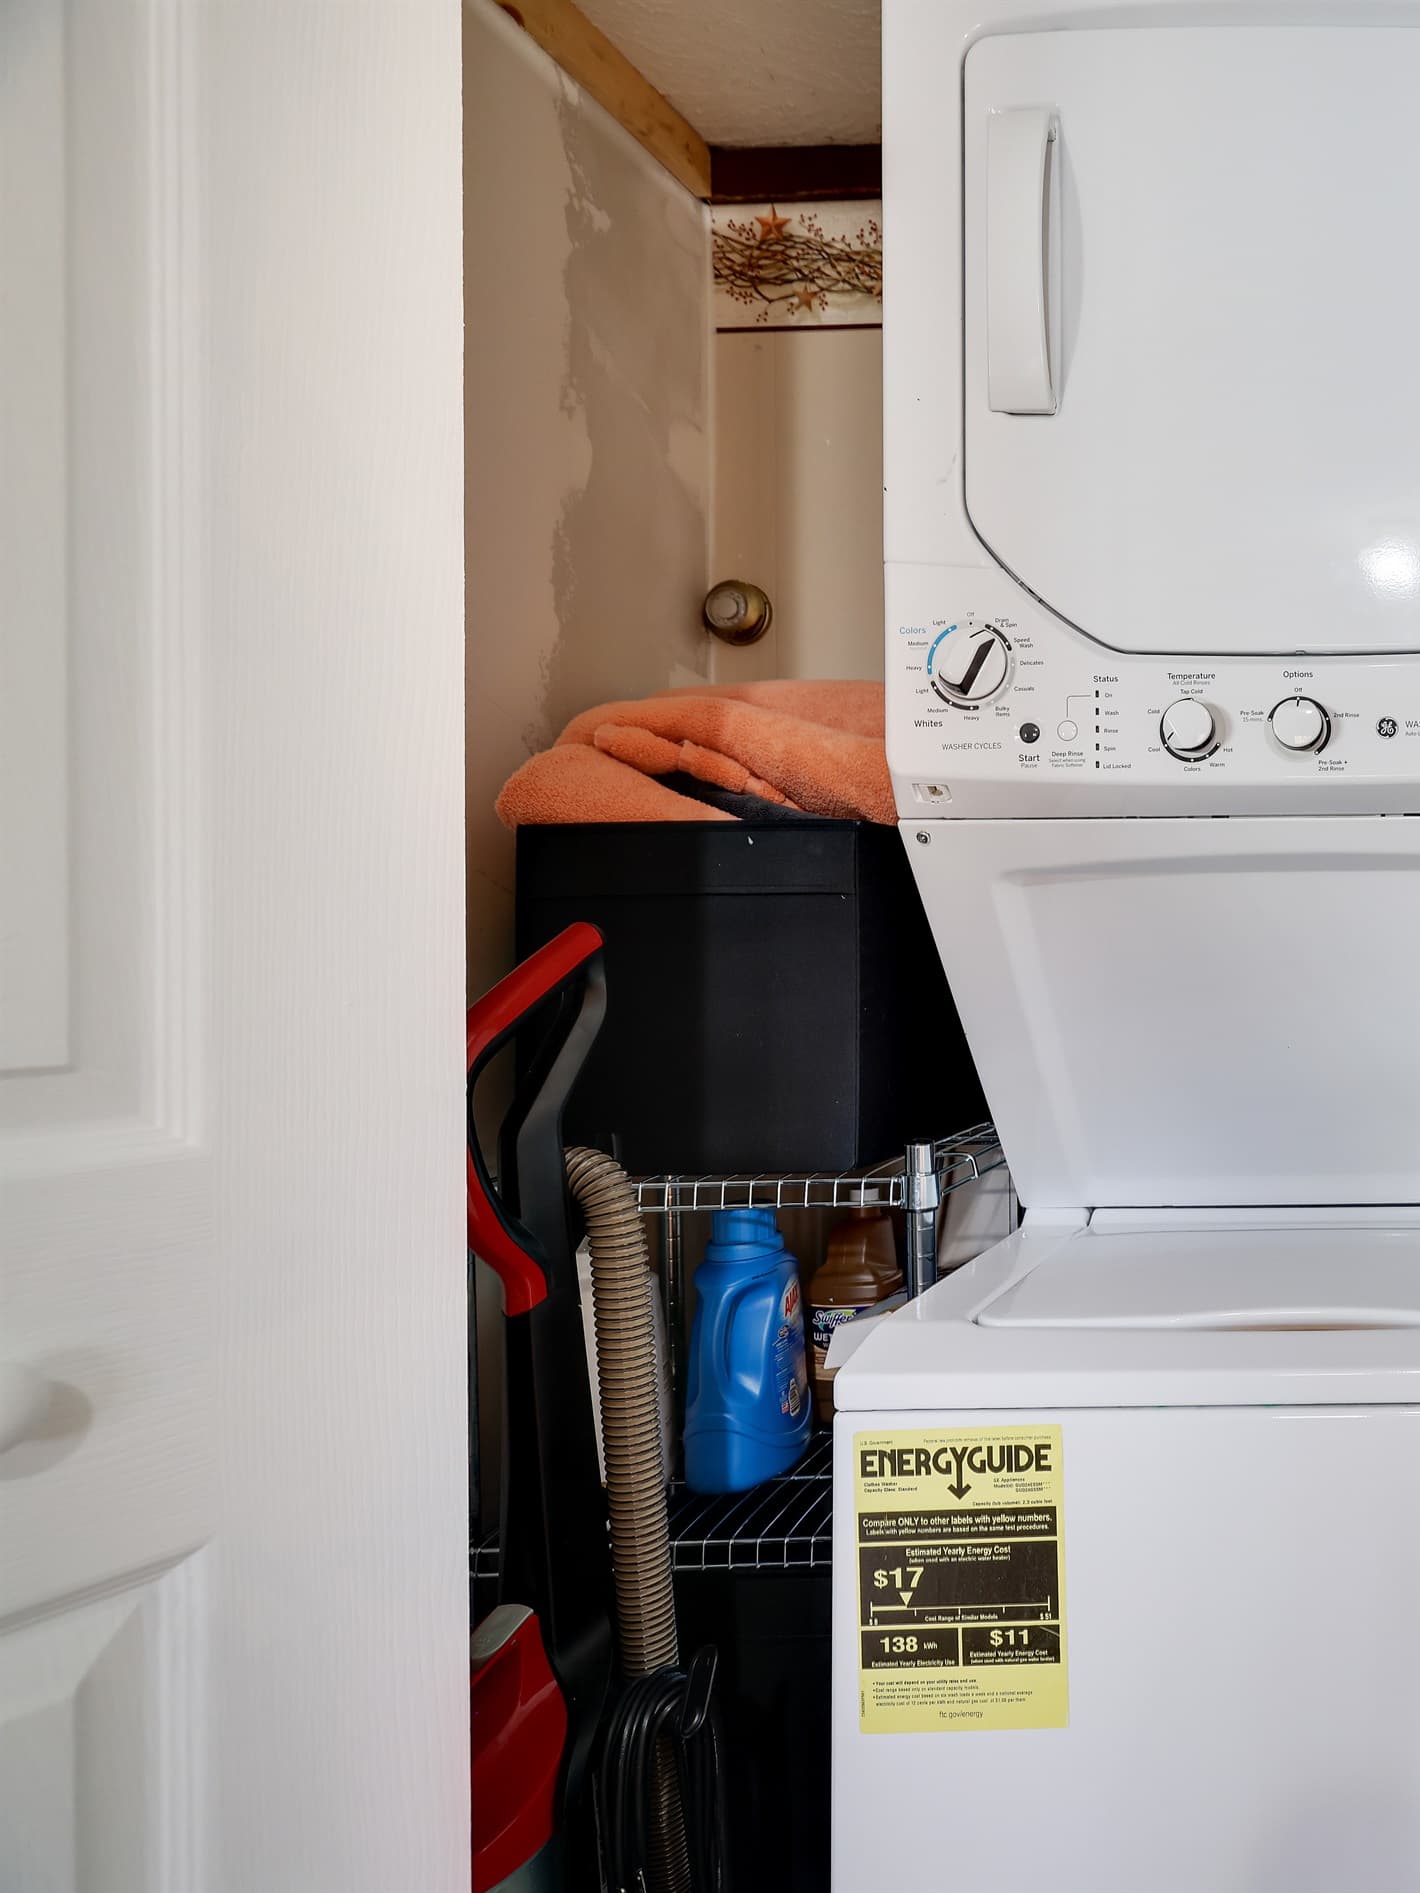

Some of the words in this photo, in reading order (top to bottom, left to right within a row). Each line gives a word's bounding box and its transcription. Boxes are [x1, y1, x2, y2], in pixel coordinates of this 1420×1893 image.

[1093, 675, 1119, 683] Status
[1167, 672, 1216, 680] Temperature
[1282, 670, 1314, 679] Options
[914, 720, 943, 728] Whites
[1018, 754, 1040, 762] Start
[860, 1444, 1052, 1478] ENERGYGUIDE
[862, 1518, 897, 1528] Compare
[897, 1517, 919, 1526] ONLY
[920, 1517, 929, 1525] to
[930, 1516, 950, 1525] other
[951, 1515, 973, 1525] labels
[974, 1514, 991, 1523] with
[992, 1513, 1016, 1525] yellow
[1017, 1512, 1052, 1521] numbers.
[898, 1527, 917, 1536] yellow
[917, 1526, 942, 1534] numbers
[1016, 1523, 1049, 1531] procedures.
[905, 1547, 942, 1557] Estimated
[943, 1547, 966, 1556] Yearly
[966, 1546, 993, 1556] Energy
[993, 1545, 1011, 1553] Cost
[873, 1567, 924, 1589] $17
[990, 1629, 1029, 1647] $11
[879, 1636, 918, 1653] 138
[923, 1642, 938, 1650] kWh
[997, 1650, 1014, 1658] Yearly
[899, 1660, 916, 1668] Yearly
[917, 1659, 944, 1667] Electricity
